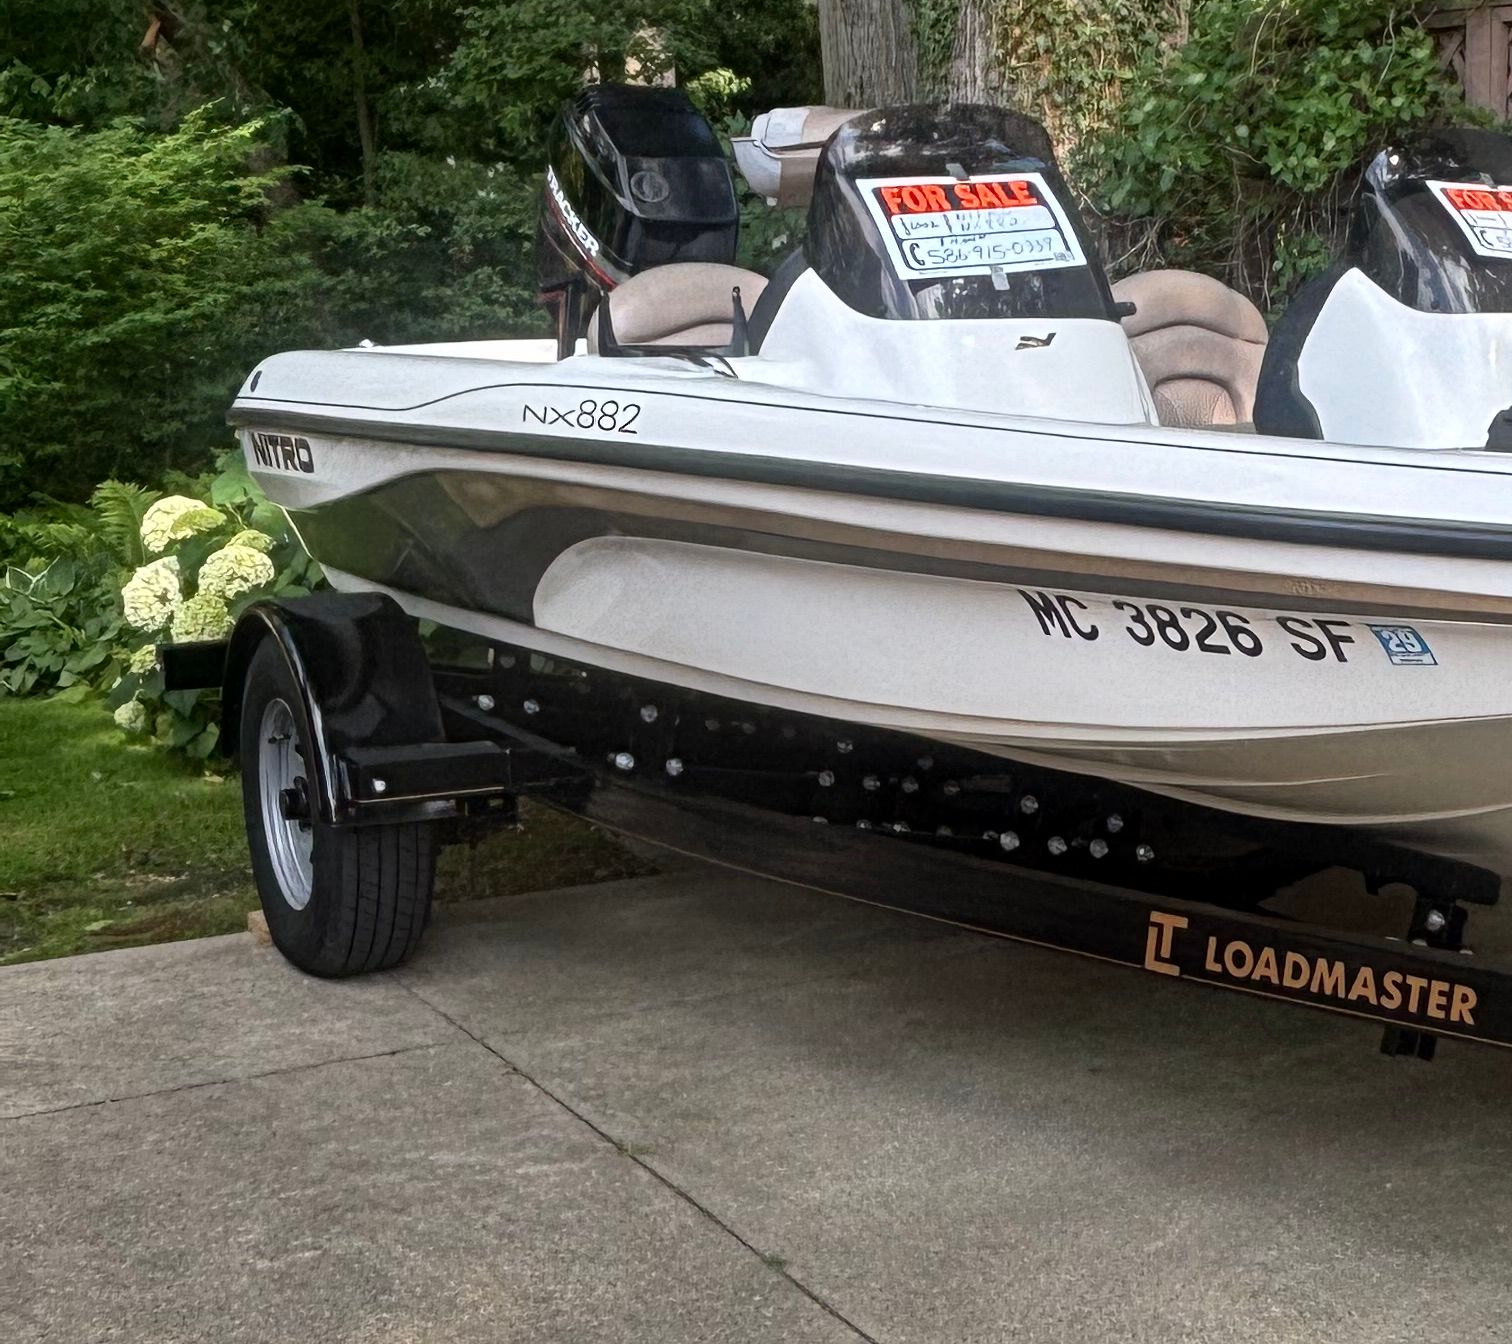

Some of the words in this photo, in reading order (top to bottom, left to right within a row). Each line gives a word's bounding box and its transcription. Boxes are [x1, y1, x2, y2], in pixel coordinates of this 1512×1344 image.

[547, 164, 600, 257] TRACKER
[881, 184, 951, 213] FOR
[953, 181, 1038, 208] SALE
[1446, 188, 1498, 211] FOR
[523, 399, 641, 434] NX882
[250, 430, 315, 474] NITRO
[1017, 588, 1099, 641] MC
[1113, 600, 1263, 657] 3826
[1275, 615, 1356, 662] SF
[1205, 935, 1478, 1025] LOADMASTER
